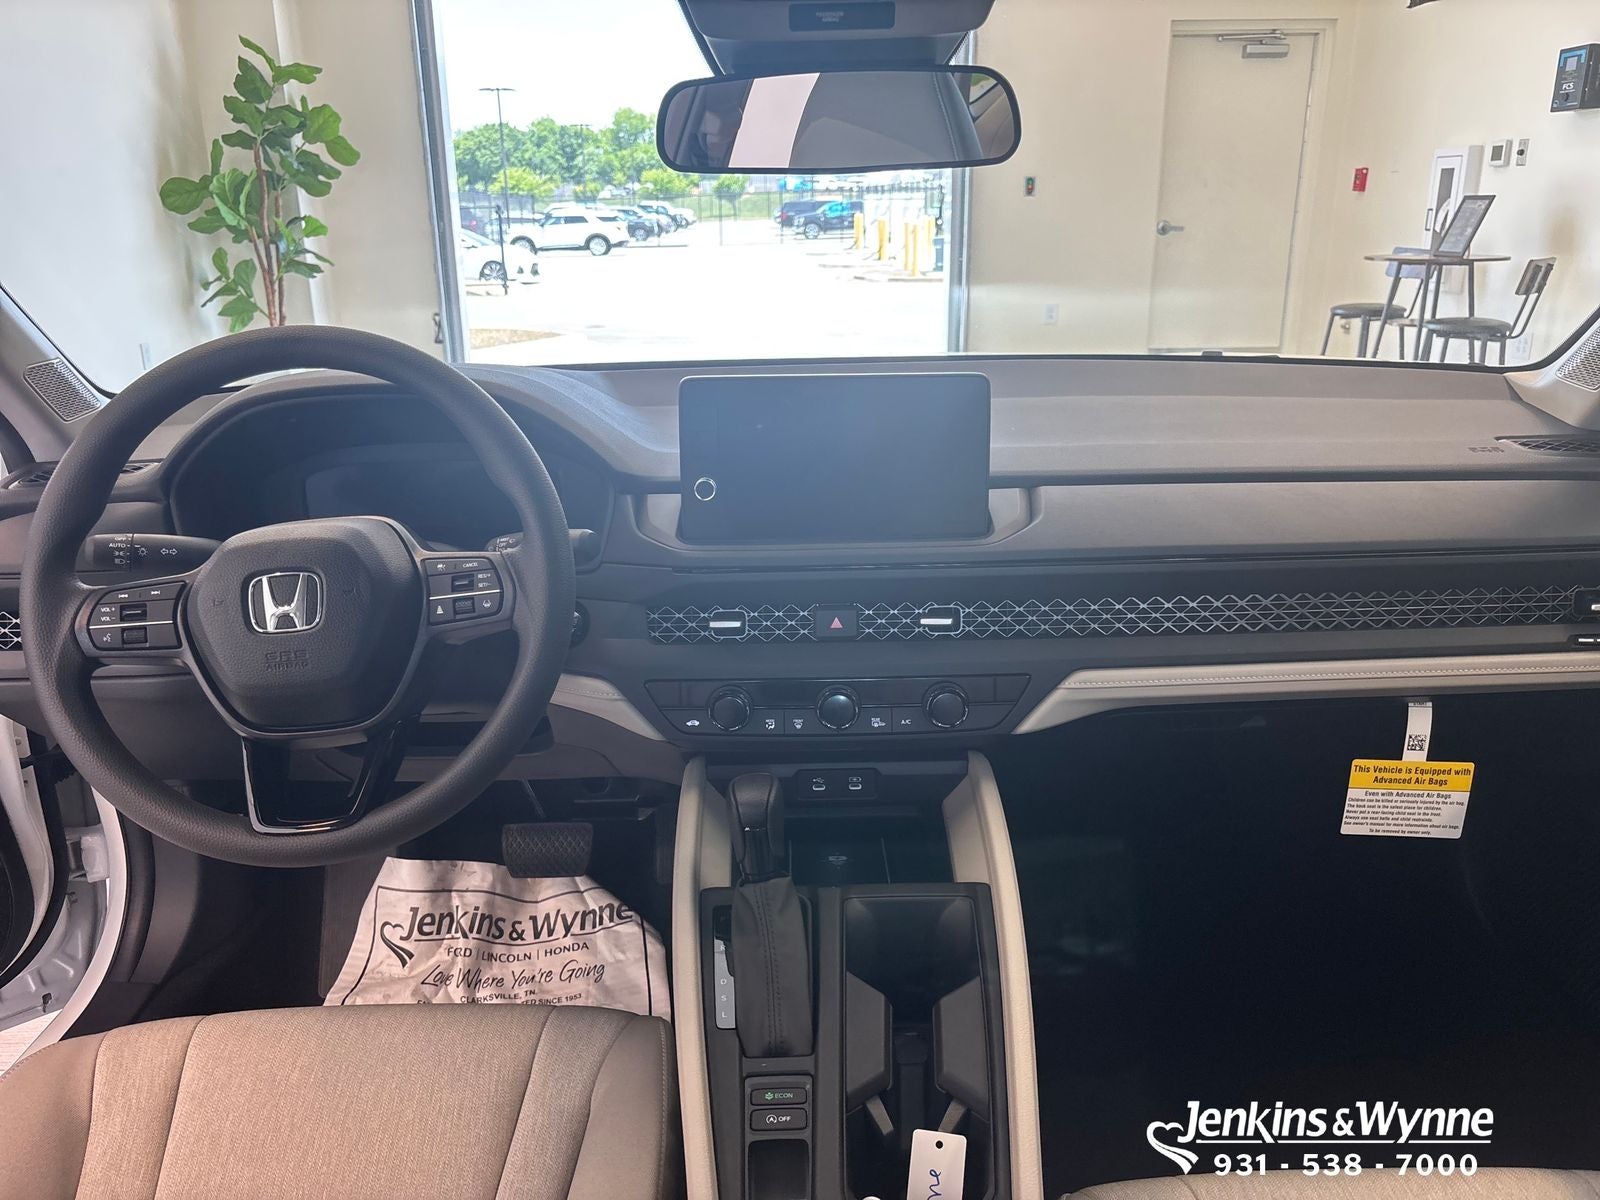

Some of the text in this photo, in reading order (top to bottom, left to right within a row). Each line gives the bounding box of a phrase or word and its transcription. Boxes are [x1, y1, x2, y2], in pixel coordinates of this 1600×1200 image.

[1354, 765, 1471, 777] This Vehicle is Equipped with
[1373, 776, 1448, 787] Advanced Air Bags
[400, 906, 505, 941] Jenkins
[529, 901, 634, 940] Wynne
[481, 951, 532, 963] LINCOLN
[544, 942, 590, 957] HONDA
[420, 959, 606, 993] Love Where You're Going
[537, 997, 562, 1005] SINCE
[565, 993, 582, 1001] 1953
